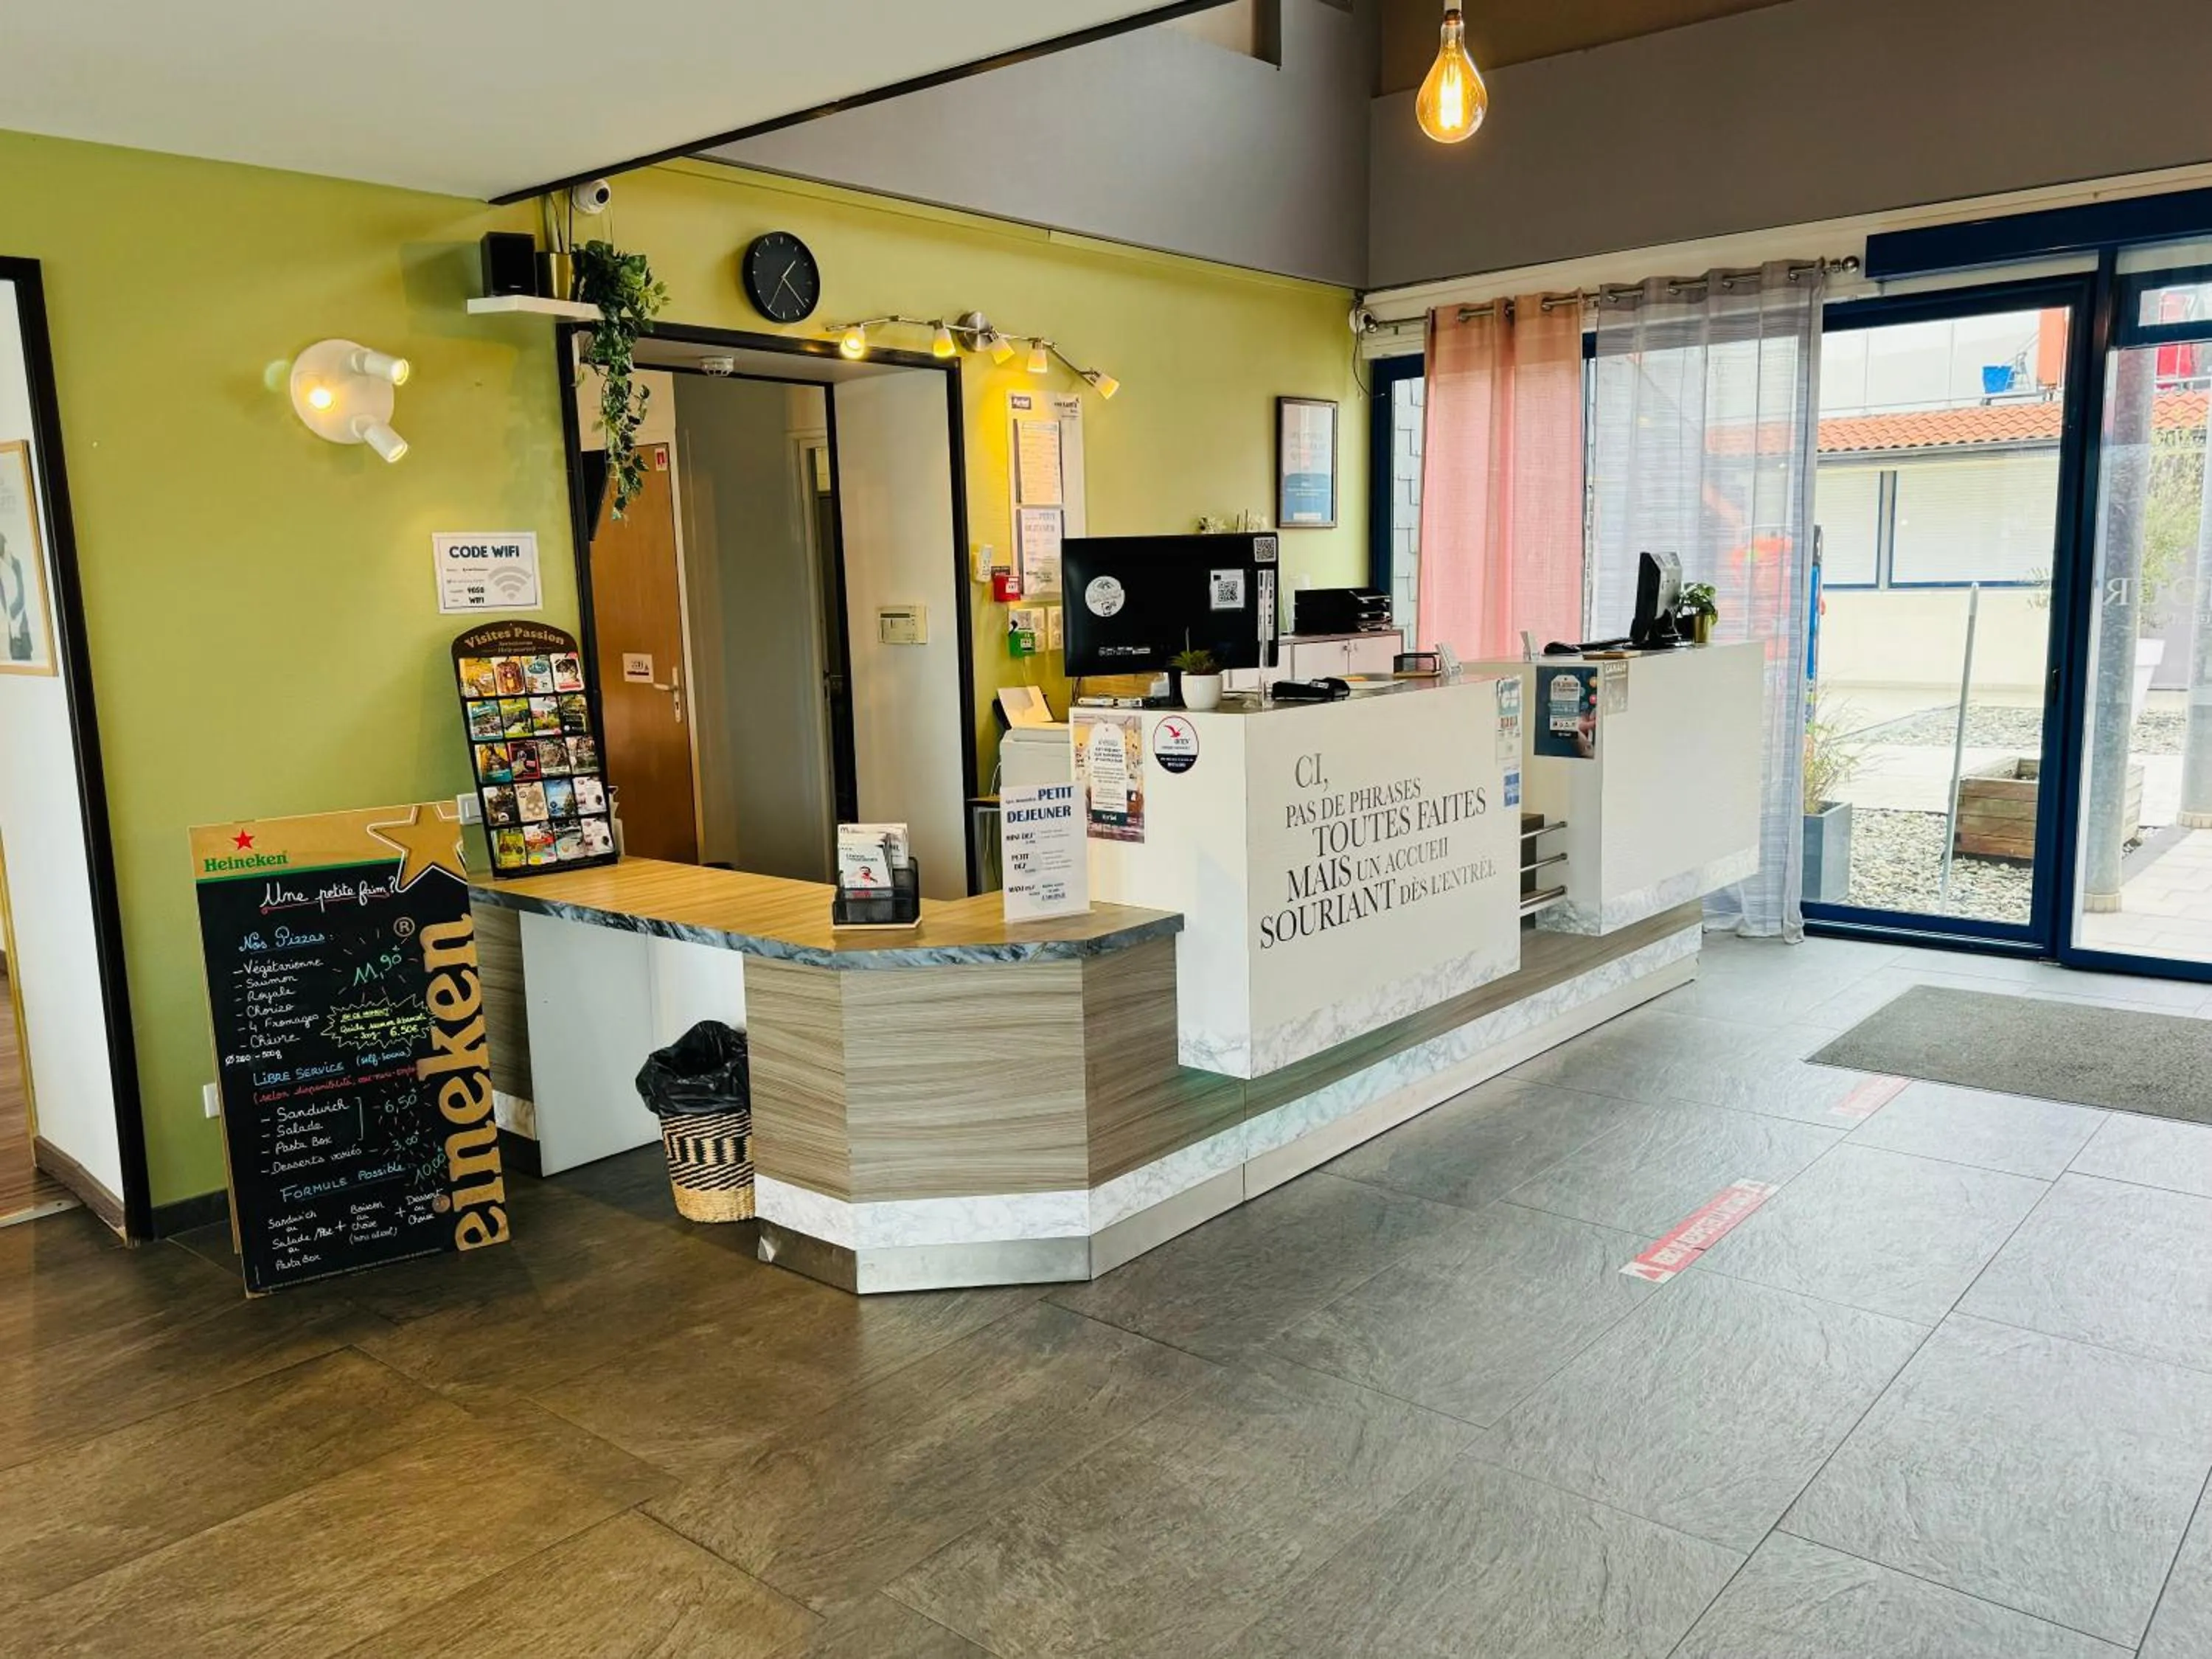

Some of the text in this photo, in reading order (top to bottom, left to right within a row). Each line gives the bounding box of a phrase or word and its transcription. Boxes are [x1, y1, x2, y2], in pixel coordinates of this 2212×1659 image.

[448, 546, 520, 558] CODE WIFI
[465, 627, 565, 648] Visites Passion
[1295, 753, 1328, 791] CI,
[1037, 785, 1074, 801] PETIT
[1285, 777, 1421, 828] PAS DE PHRASES
[1007, 805, 1071, 823] DEJEUNER
[1312, 786, 1486, 857] TOUTES FAITES
[204, 850, 290, 872] Heineken
[1287, 855, 1352, 902] MAIS
[1357, 855, 1380, 881] UN
[260, 882, 308, 908] Une
[315, 883, 356, 913] petite
[1260, 878, 1396, 950] SOURIANT
[1400, 875, 1428, 905] DÈS
[238, 932, 268, 952] Nos
[246, 975, 299, 989] Saumon
[247, 987, 296, 1004] Royale
[246, 1004, 295, 1018] Chorizo
[248, 1014, 319, 1032] 4 Fromages
[250, 1033, 301, 1047] Chèvre
[276, 1099, 350, 1121] Sandwich
[276, 1121, 324, 1137] Salade
[275, 1136, 333, 1155] Pasta Box
[271, 1156, 324, 1175] Desserts
[280, 1178, 348, 1202] FORMULE
